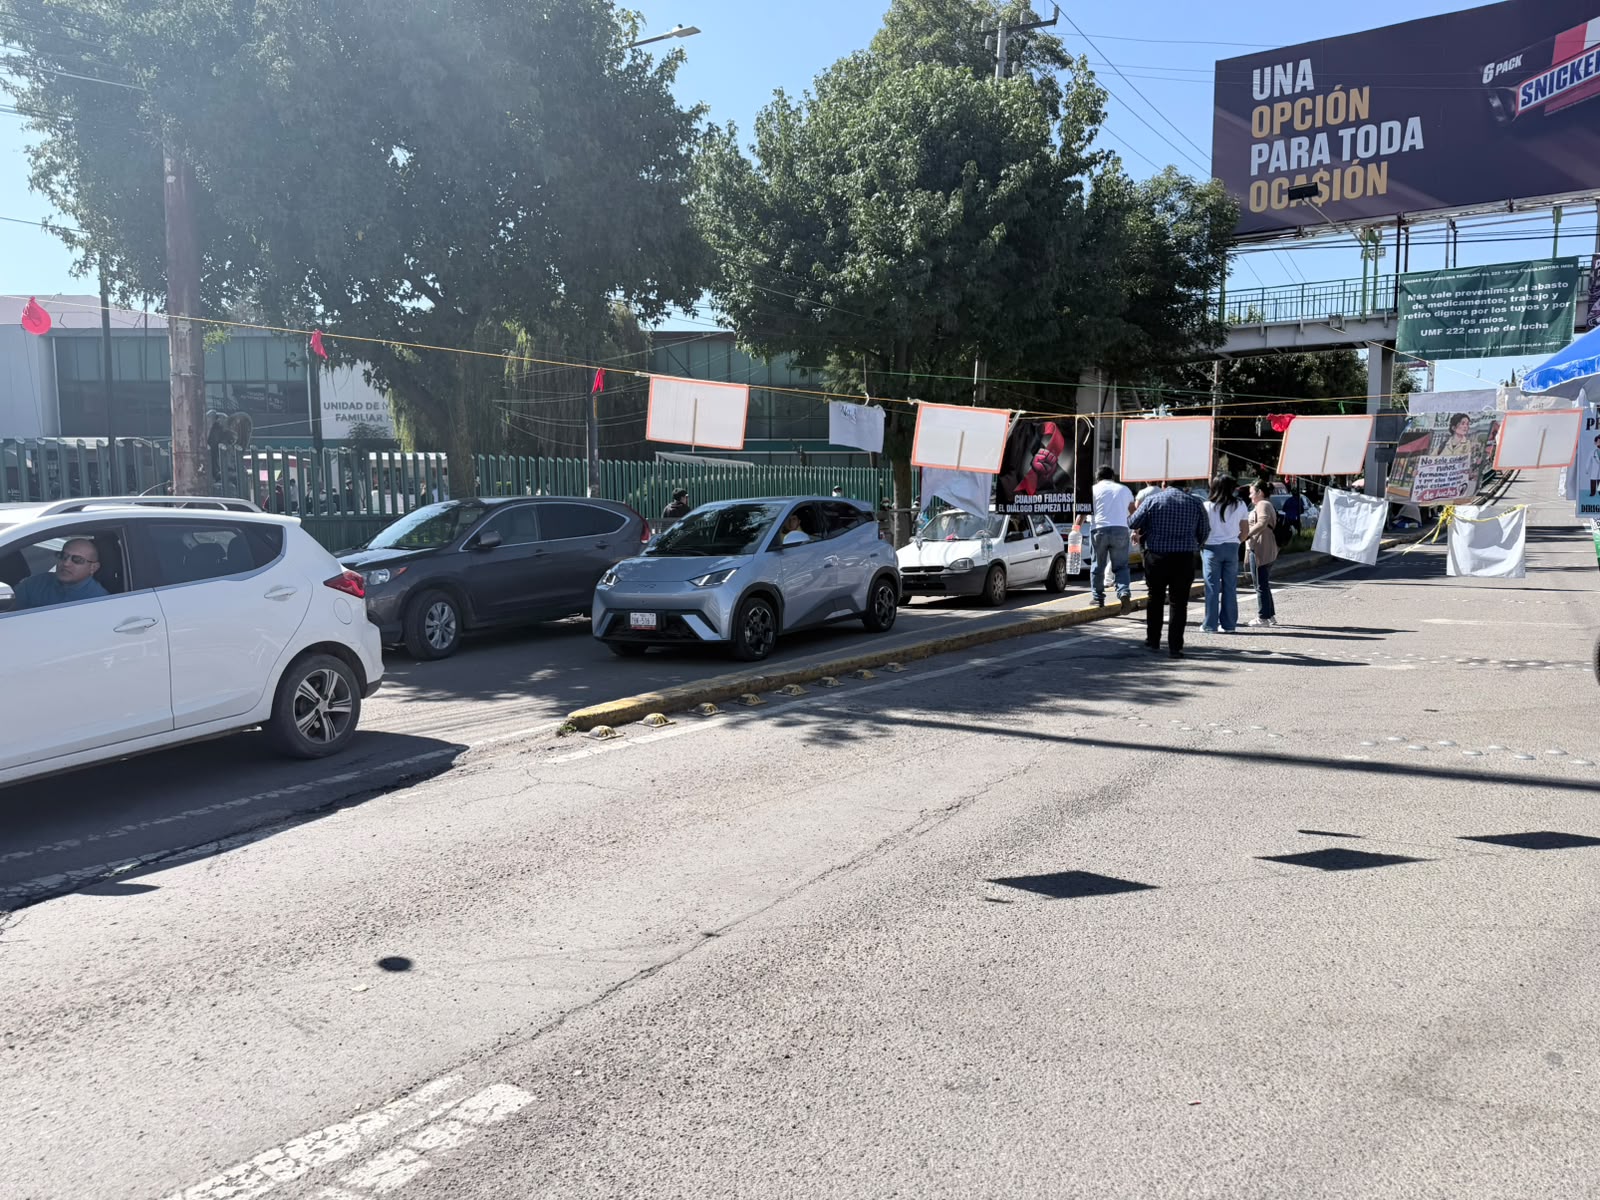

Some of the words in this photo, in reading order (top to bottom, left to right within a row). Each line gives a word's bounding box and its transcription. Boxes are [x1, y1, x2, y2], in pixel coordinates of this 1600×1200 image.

[1482, 62, 1496, 84] 6
[1495, 54, 1523, 76] PACK
[1252, 58, 1315, 100] UNA
[1251, 84, 1370, 139] OPCIÓN
[1250, 132, 1331, 176] PARA
[1338, 116, 1424, 162] TODA
[1407, 292, 1428, 302] Más
[1430, 289, 1452, 299] vale
[1518, 284, 1528, 292] el
[1531, 280, 1569, 291] abasto
[1412, 302, 1425, 310] de
[1427, 297, 1507, 309] medicamentos,
[1510, 292, 1549, 304] trabajo
[1552, 292, 1559, 300] y
[1403, 311, 1431, 320] retiro
[1434, 308, 1468, 319] dignos
[1471, 308, 1489, 317] por
[1510, 303, 1540, 314] tuyos
[1542, 303, 1549, 311] y
[1552, 301, 1571, 310] por
[1479, 315, 1507, 324] míos.
[1420, 328, 1443, 337] UMF
[1446, 327, 1465, 335] 222
[1484, 325, 1499, 334] pie
[1519, 322, 1549, 331] lucha
[323, 402, 363, 411] UNIDAD
[366, 401, 380, 410] DE
[335, 413, 383, 422] FAMILIAR
[1421, 457, 1433, 465] No
[1014, 494, 1042, 504] CUANDO
[998, 504, 1005, 512] EL
[1006, 502, 1032, 513] DIÁLOGO
[1034, 503, 1061, 512] EMPIEZA
[1062, 503, 1071, 512] LA
